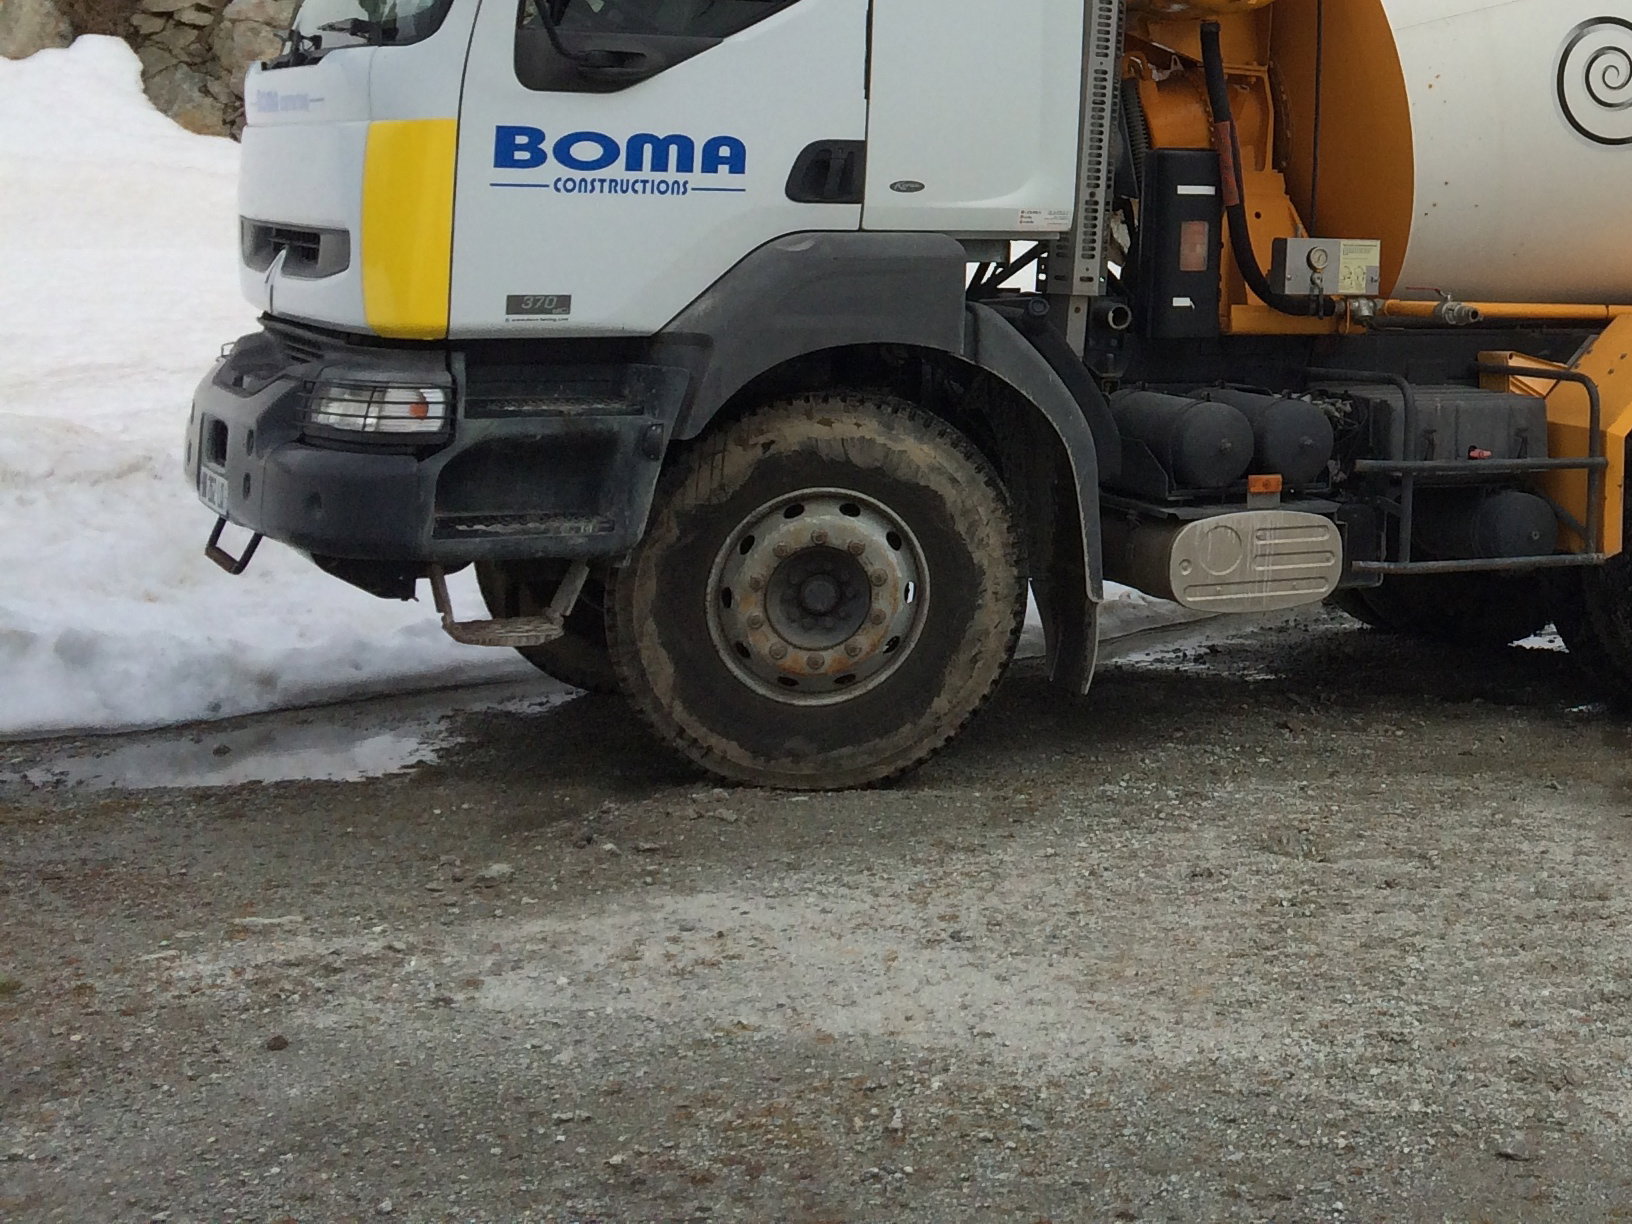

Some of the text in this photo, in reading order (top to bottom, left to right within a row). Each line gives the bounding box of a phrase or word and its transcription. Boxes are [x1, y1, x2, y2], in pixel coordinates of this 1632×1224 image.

[494, 125, 746, 174] BOMA
[553, 177, 688, 194] CONSTRUCTIONS
[521, 296, 557, 309] 370
